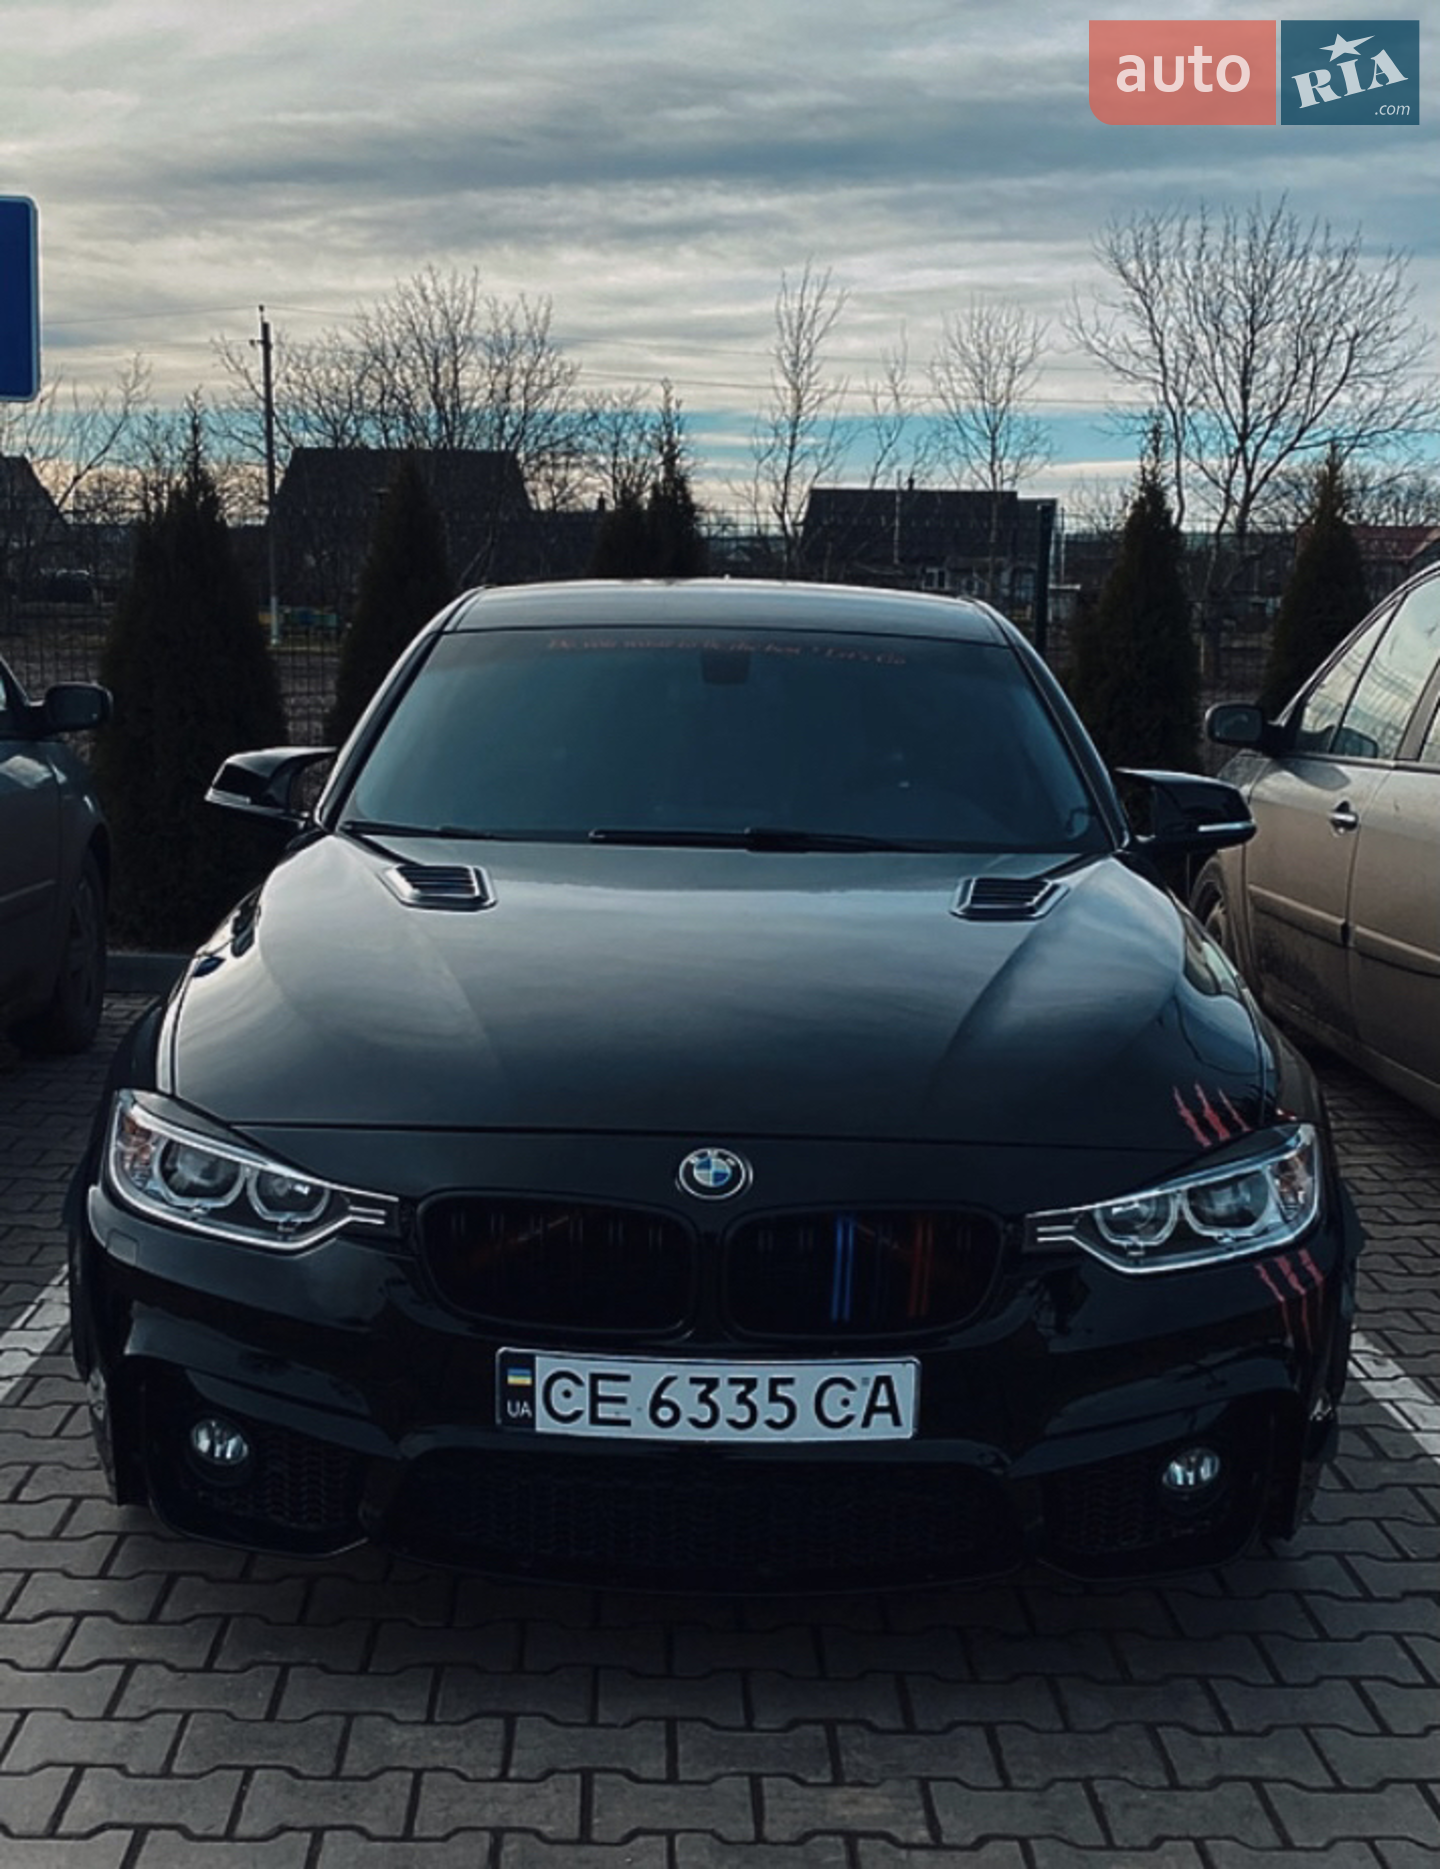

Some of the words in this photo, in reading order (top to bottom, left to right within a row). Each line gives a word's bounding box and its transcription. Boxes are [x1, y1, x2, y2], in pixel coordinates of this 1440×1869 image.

[507, 1401, 533, 1418] UA
[542, 1370, 632, 1427] CE
[648, 1375, 798, 1431] 6335
[814, 1374, 902, 1430] CA
